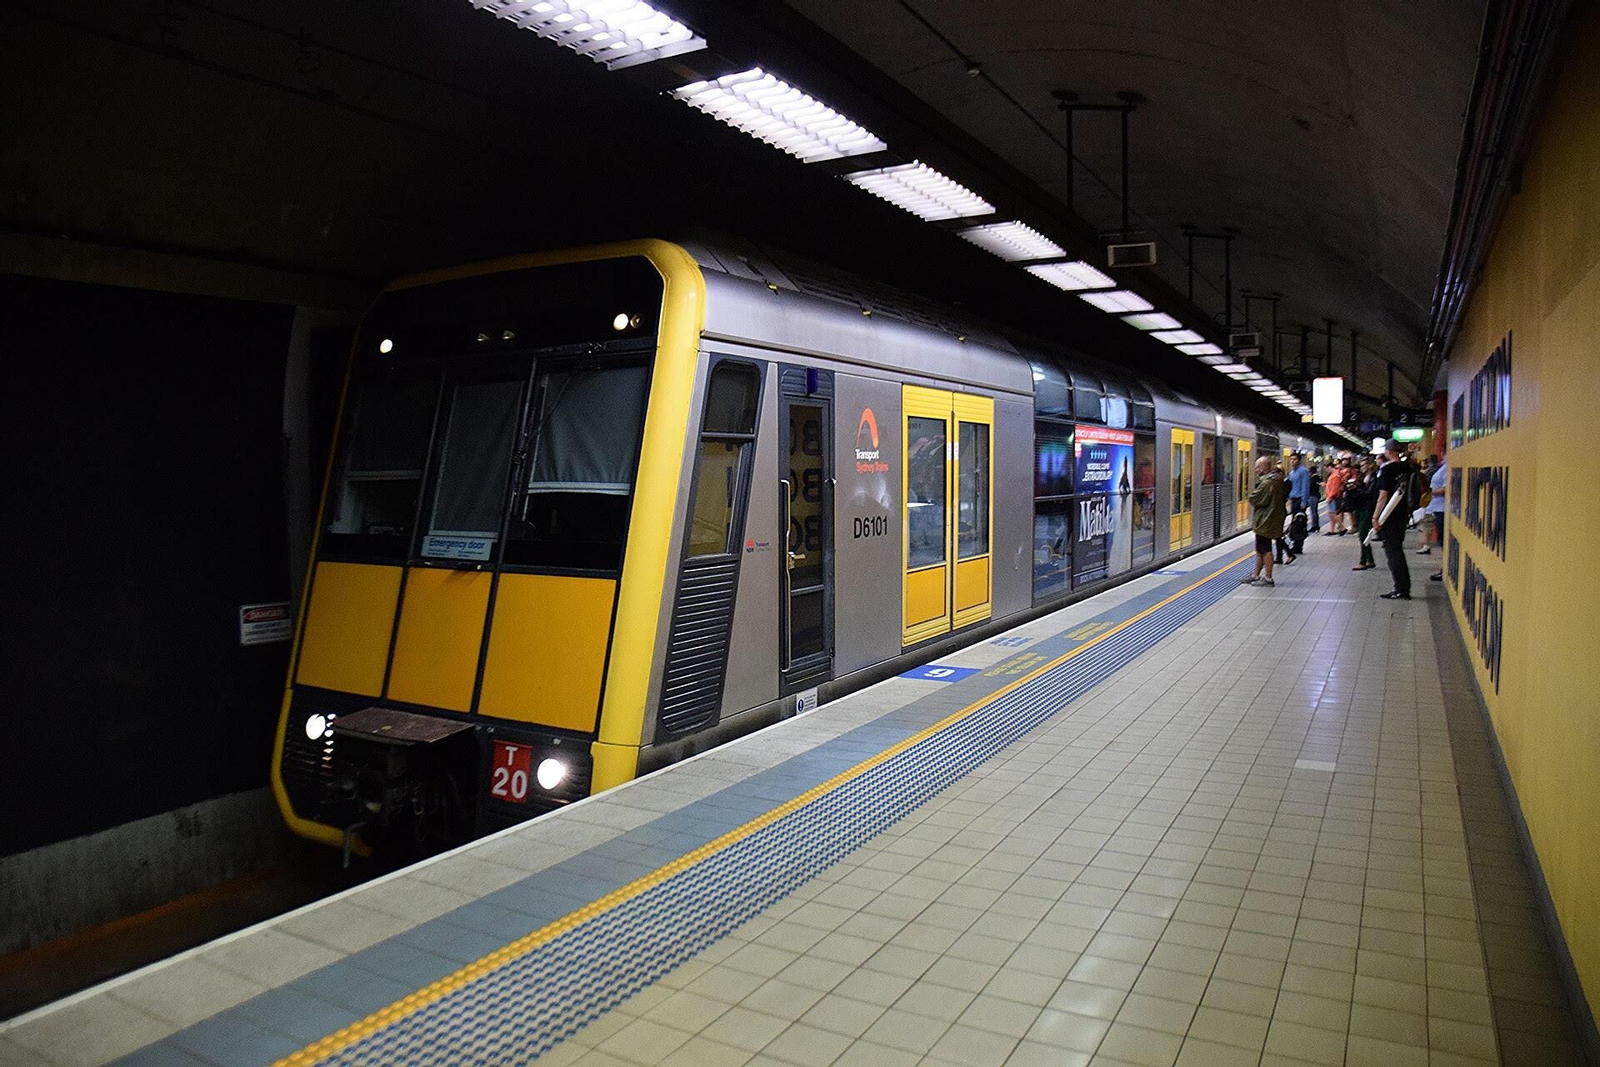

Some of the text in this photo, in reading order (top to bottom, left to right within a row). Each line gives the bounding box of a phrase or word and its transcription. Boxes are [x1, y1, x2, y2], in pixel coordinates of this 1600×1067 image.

[1349, 411, 1358, 421] 2
[1400, 413, 1408, 423] 2
[855, 448, 879, 461] Transport
[856, 461, 890, 473] Sydney Trains
[1078, 496, 1114, 542] Matilda
[853, 515, 888, 539] D6101
[429, 537, 485, 550] Emergency door
[505, 745, 518, 767] T
[491, 767, 528, 799] 20
